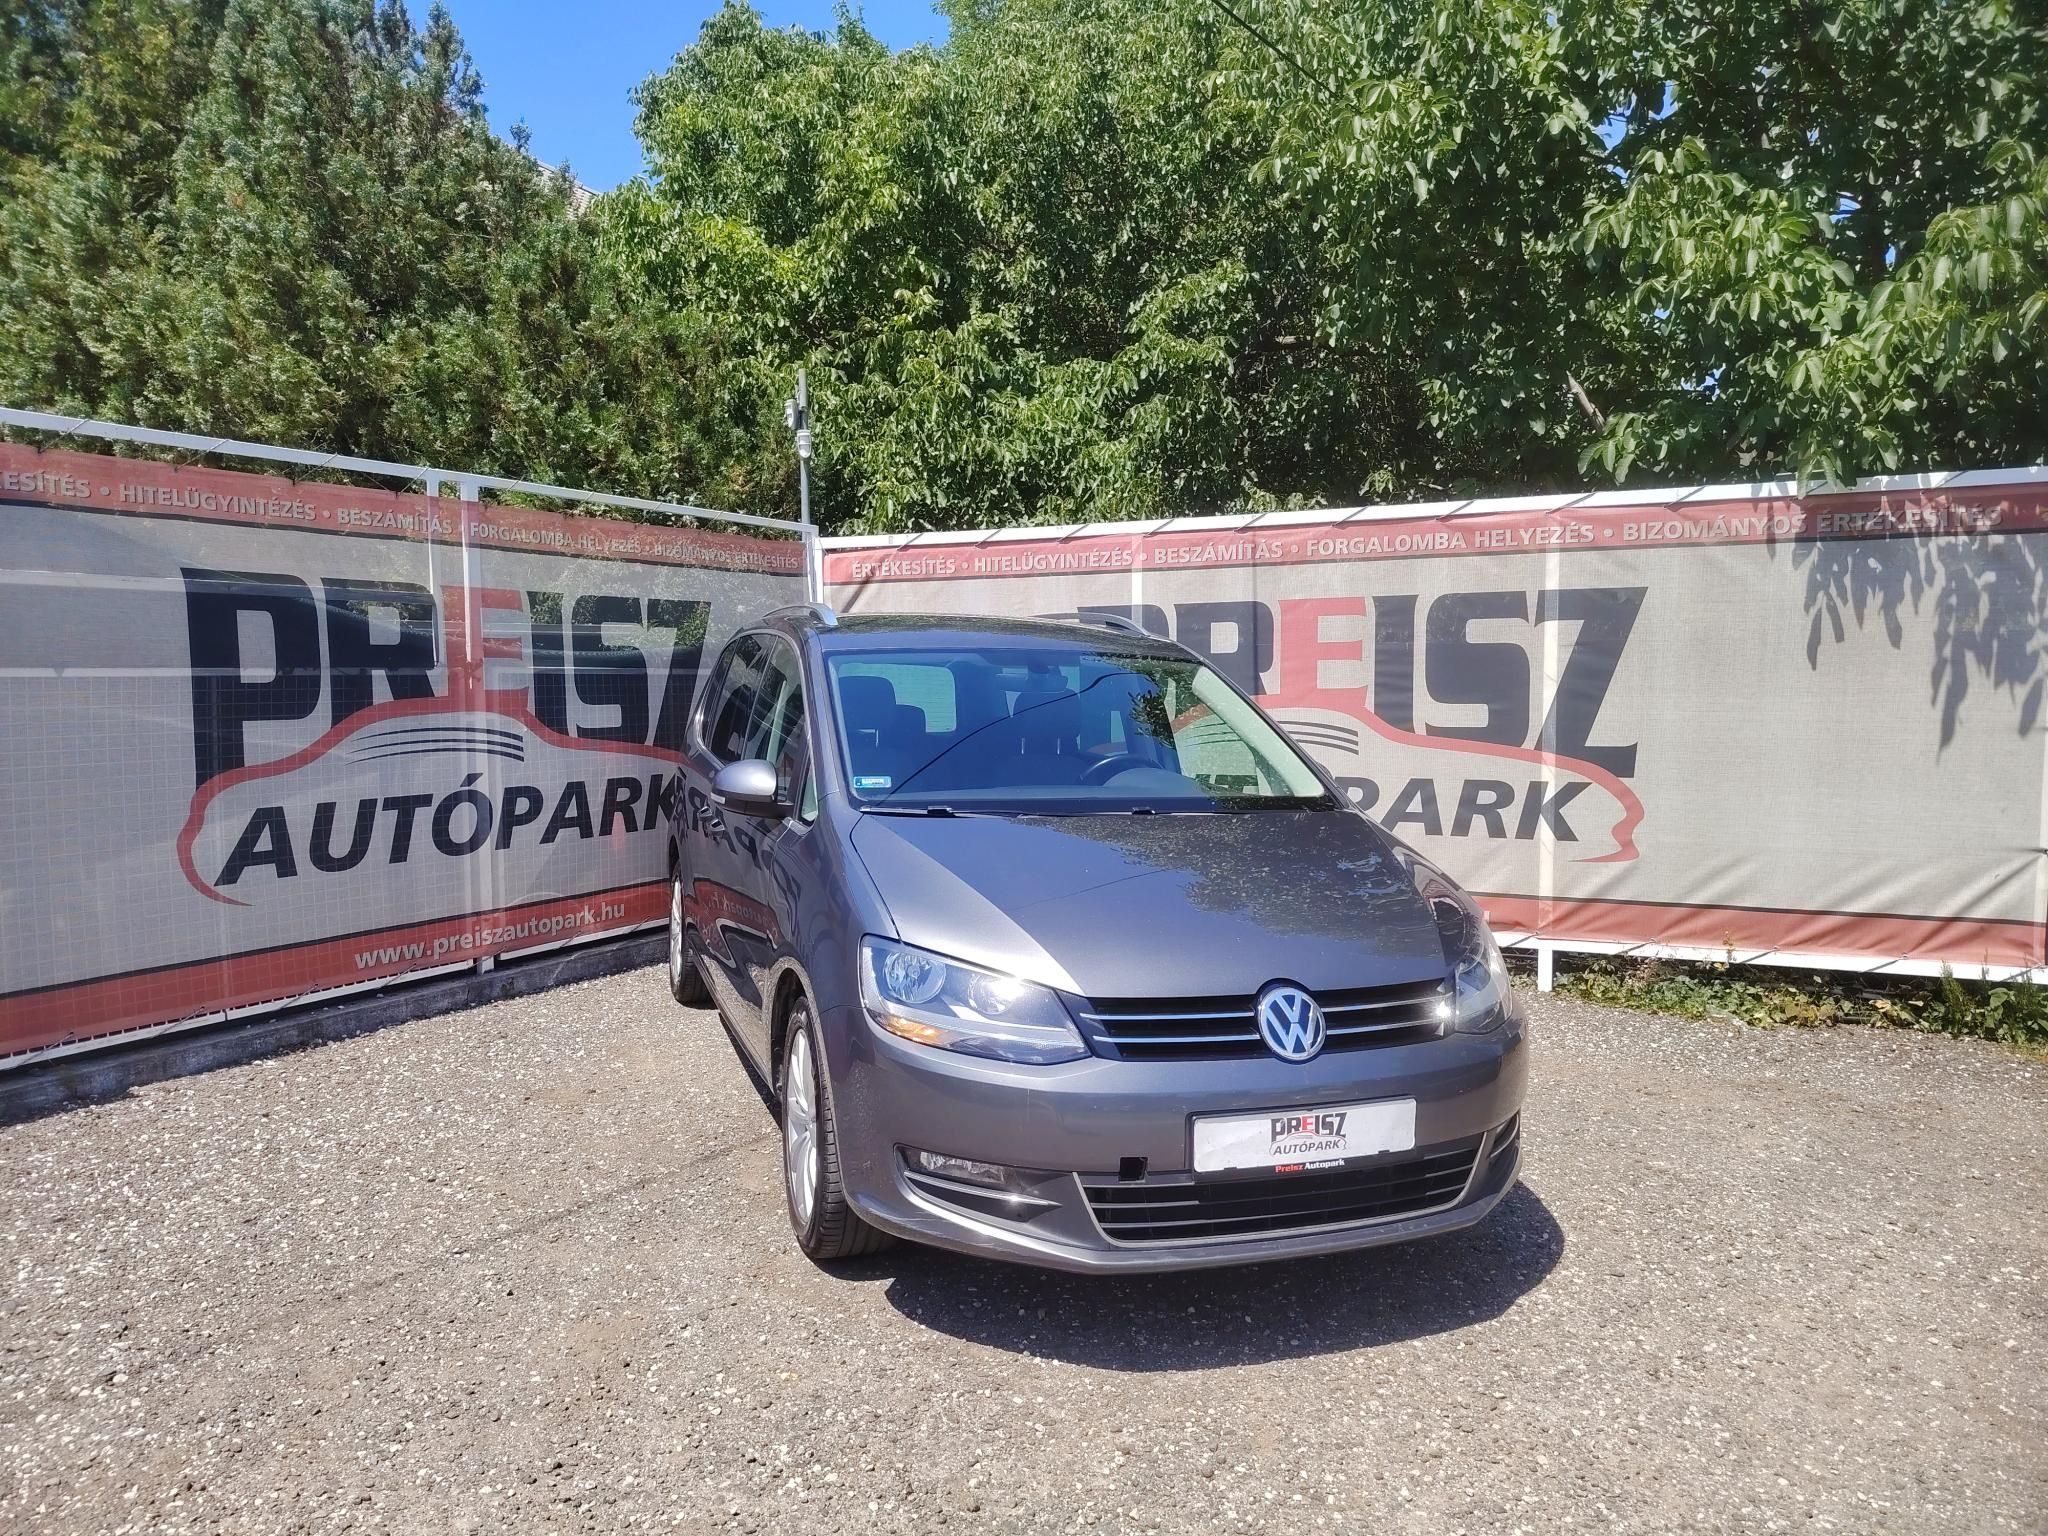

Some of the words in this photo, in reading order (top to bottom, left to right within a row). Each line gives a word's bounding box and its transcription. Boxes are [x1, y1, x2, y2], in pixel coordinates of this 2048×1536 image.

[0, 470, 92, 498] ESÍTÉS
[119, 483, 316, 521] HITELÜGYINTÉZÉS
[337, 507, 453, 534] BESZÁMÍTÁS
[470, 522, 574, 547] FORGALOMBA
[852, 556, 956, 579] ÉRTÉKESÍTÉS
[973, 547, 1133, 573] HITELÜGYINTÉZÉS
[1154, 537, 1283, 566] BESZÁMÍTÁS
[1306, 531, 1467, 557] FORGALOMBA
[1474, 521, 1595, 548] HELYEZÉS
[1622, 513, 1806, 541] BIZOMÁNYOS
[1816, 503, 2004, 533] ÉRTÉKESÍTÉS
[180, 567, 711, 791] PREISZ
[1077, 587, 1648, 778] REISZ
[213, 772, 677, 887] AUTÓPARK
[354, 902, 625, 969] www.preiszautopark.hu
[1271, 1112, 1347, 1142] PREISZ
[1273, 1140, 1341, 1155] AUTÓPARK
[1275, 1164, 1303, 1173] Preisz
[1304, 1159, 1345, 1170] Autopark
